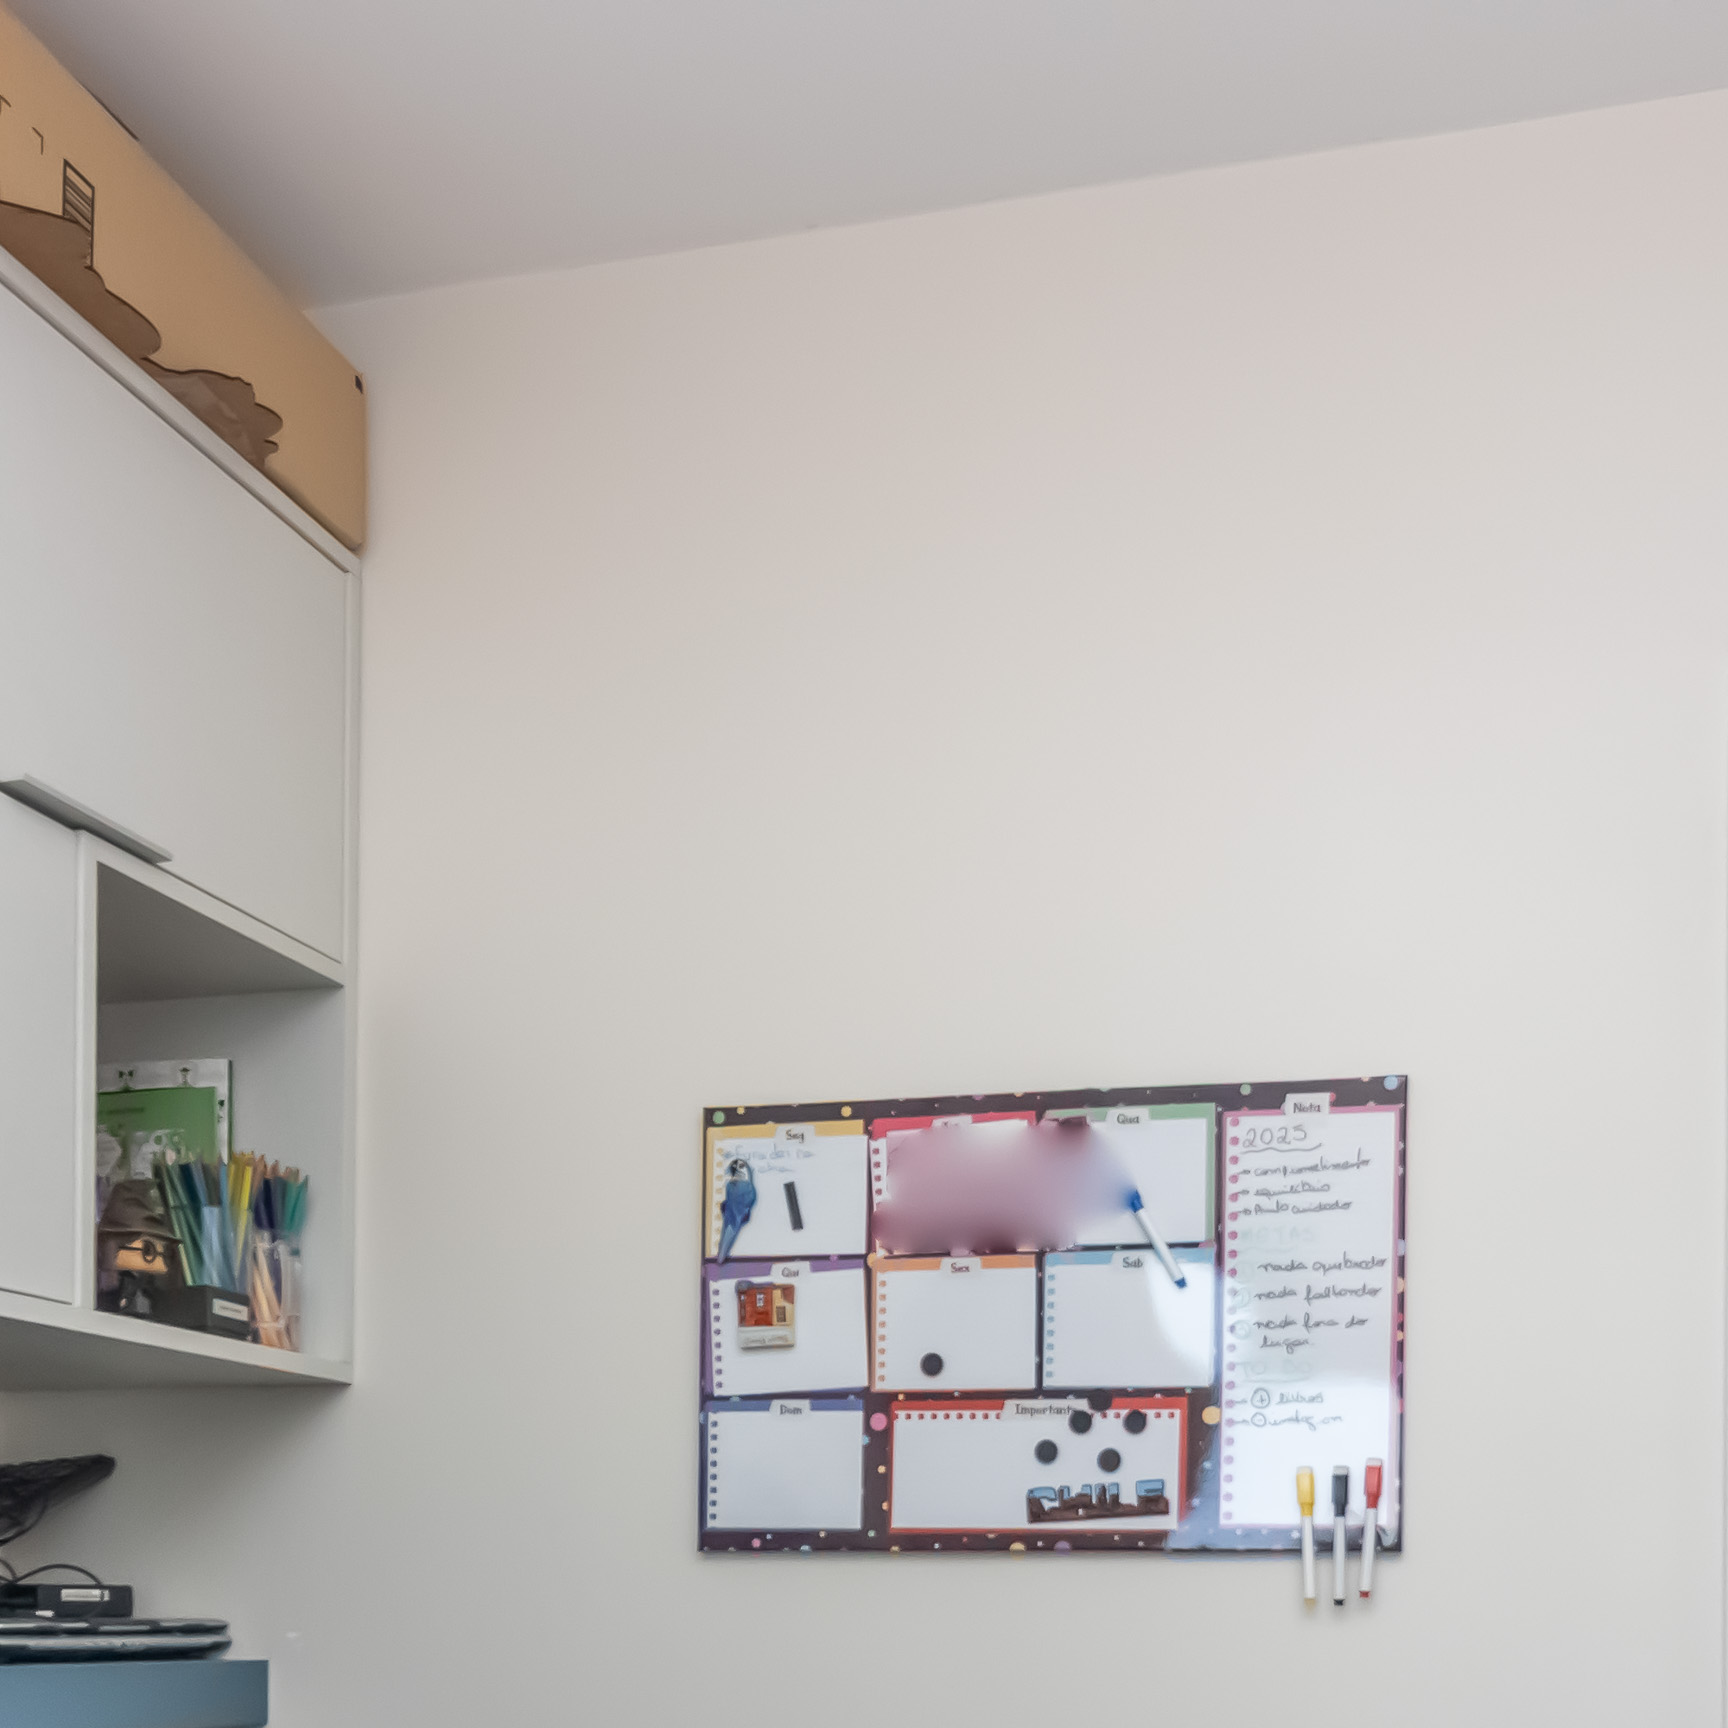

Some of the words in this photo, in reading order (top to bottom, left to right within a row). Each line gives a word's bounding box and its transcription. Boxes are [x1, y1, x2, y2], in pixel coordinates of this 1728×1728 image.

[1293, 1102, 1321, 1114] Nota
[785, 1129, 805, 1143] Seg
[1242, 1124, 1308, 1148] 2025
[1015, 1403, 1075, 1416] Important
